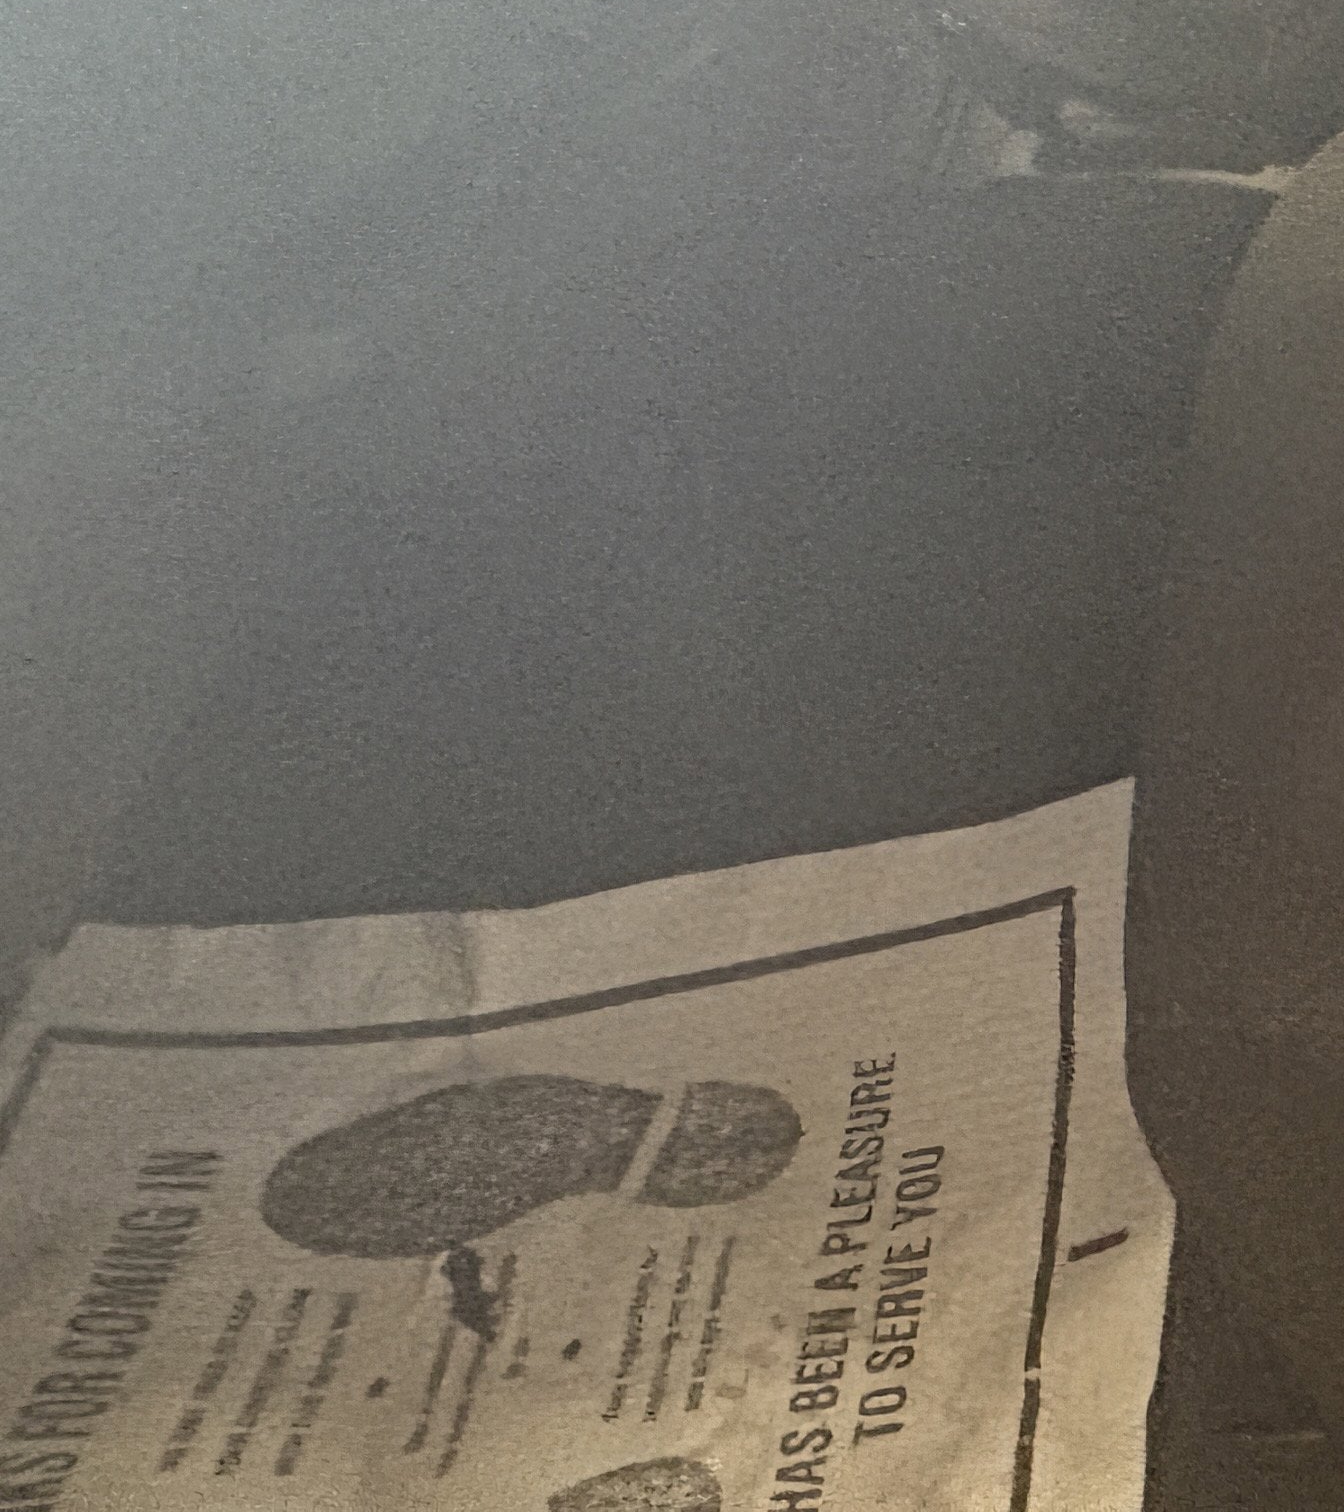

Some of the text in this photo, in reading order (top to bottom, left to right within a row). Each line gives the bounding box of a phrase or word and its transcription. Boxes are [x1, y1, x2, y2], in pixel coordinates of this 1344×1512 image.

[136, 1150, 224, 1191] IN
[52, 1206, 201, 1360] COMING
[814, 1264, 864, 1294] A
[852, 1144, 945, 1450] TO SERVE YOU
[788, 1307, 857, 1413] BEEN
[3, 1371, 128, 1441] FOR
[767, 1428, 834, 1512] HAS
